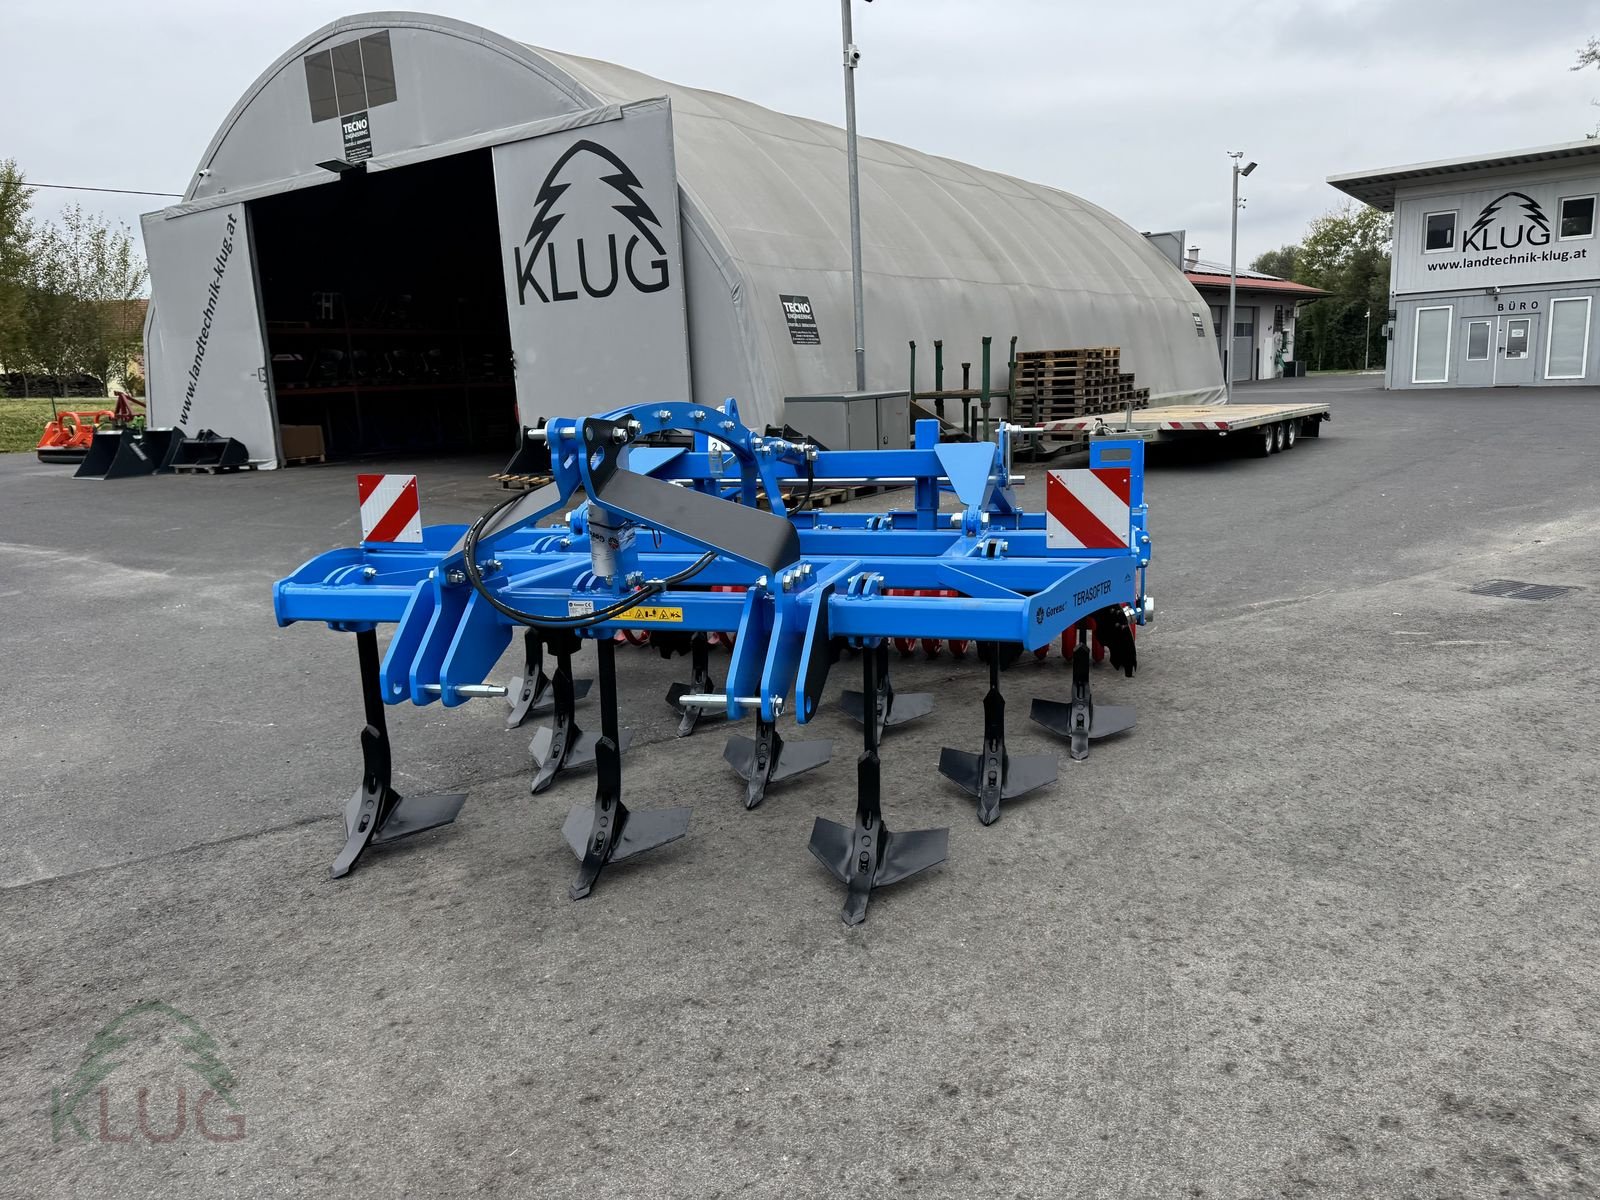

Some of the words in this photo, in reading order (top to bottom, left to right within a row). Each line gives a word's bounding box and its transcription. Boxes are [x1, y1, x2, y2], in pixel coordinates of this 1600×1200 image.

[343, 119, 367, 134] TECNO
[1462, 225, 1550, 252] KLUG
[514, 234, 670, 306] KLUG
[1427, 249, 1587, 271] www.landtechnik-klug.at
[783, 302, 810, 313] TECNO
[1497, 301, 1539, 311] BÜRO
[179, 213, 237, 425] www.landtechnik-klug.at
[1073, 580, 1112, 607] TERASOFTER
